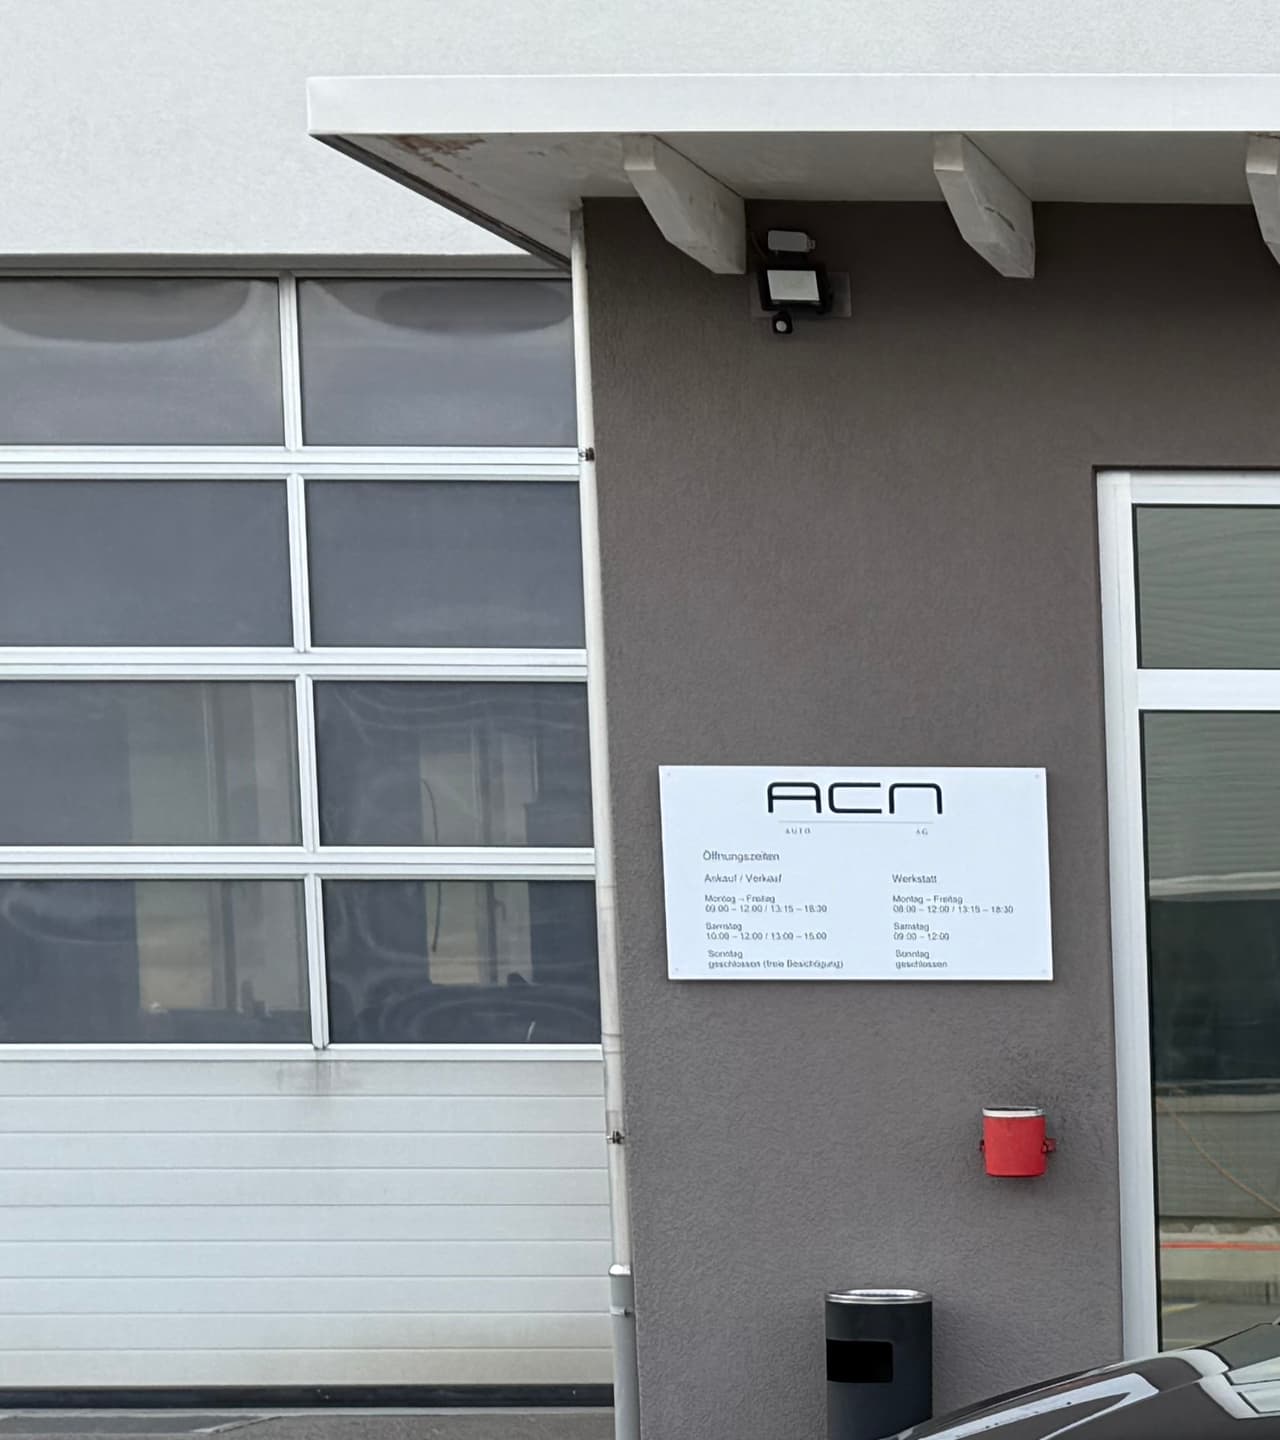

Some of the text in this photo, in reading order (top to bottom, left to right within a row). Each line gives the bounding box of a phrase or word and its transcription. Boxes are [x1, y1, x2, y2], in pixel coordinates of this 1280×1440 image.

[767, 782, 943, 814] ACN
[703, 850, 780, 863] Öffnungszeiten
[704, 874, 737, 883] Ankauf
[745, 874, 782, 883] Verkauf
[892, 874, 937, 883] Werkstatt
[704, 894, 736, 904] Montag
[746, 894, 776, 904] Freitag
[892, 895, 924, 904] Montag
[933, 895, 963, 904] Freitag
[705, 922, 742, 931] Samstag
[893, 922, 929, 932] Samstag
[707, 950, 743, 959] Sonntag
[896, 950, 930, 959] Sonntag
[896, 960, 948, 969] geschlossen
